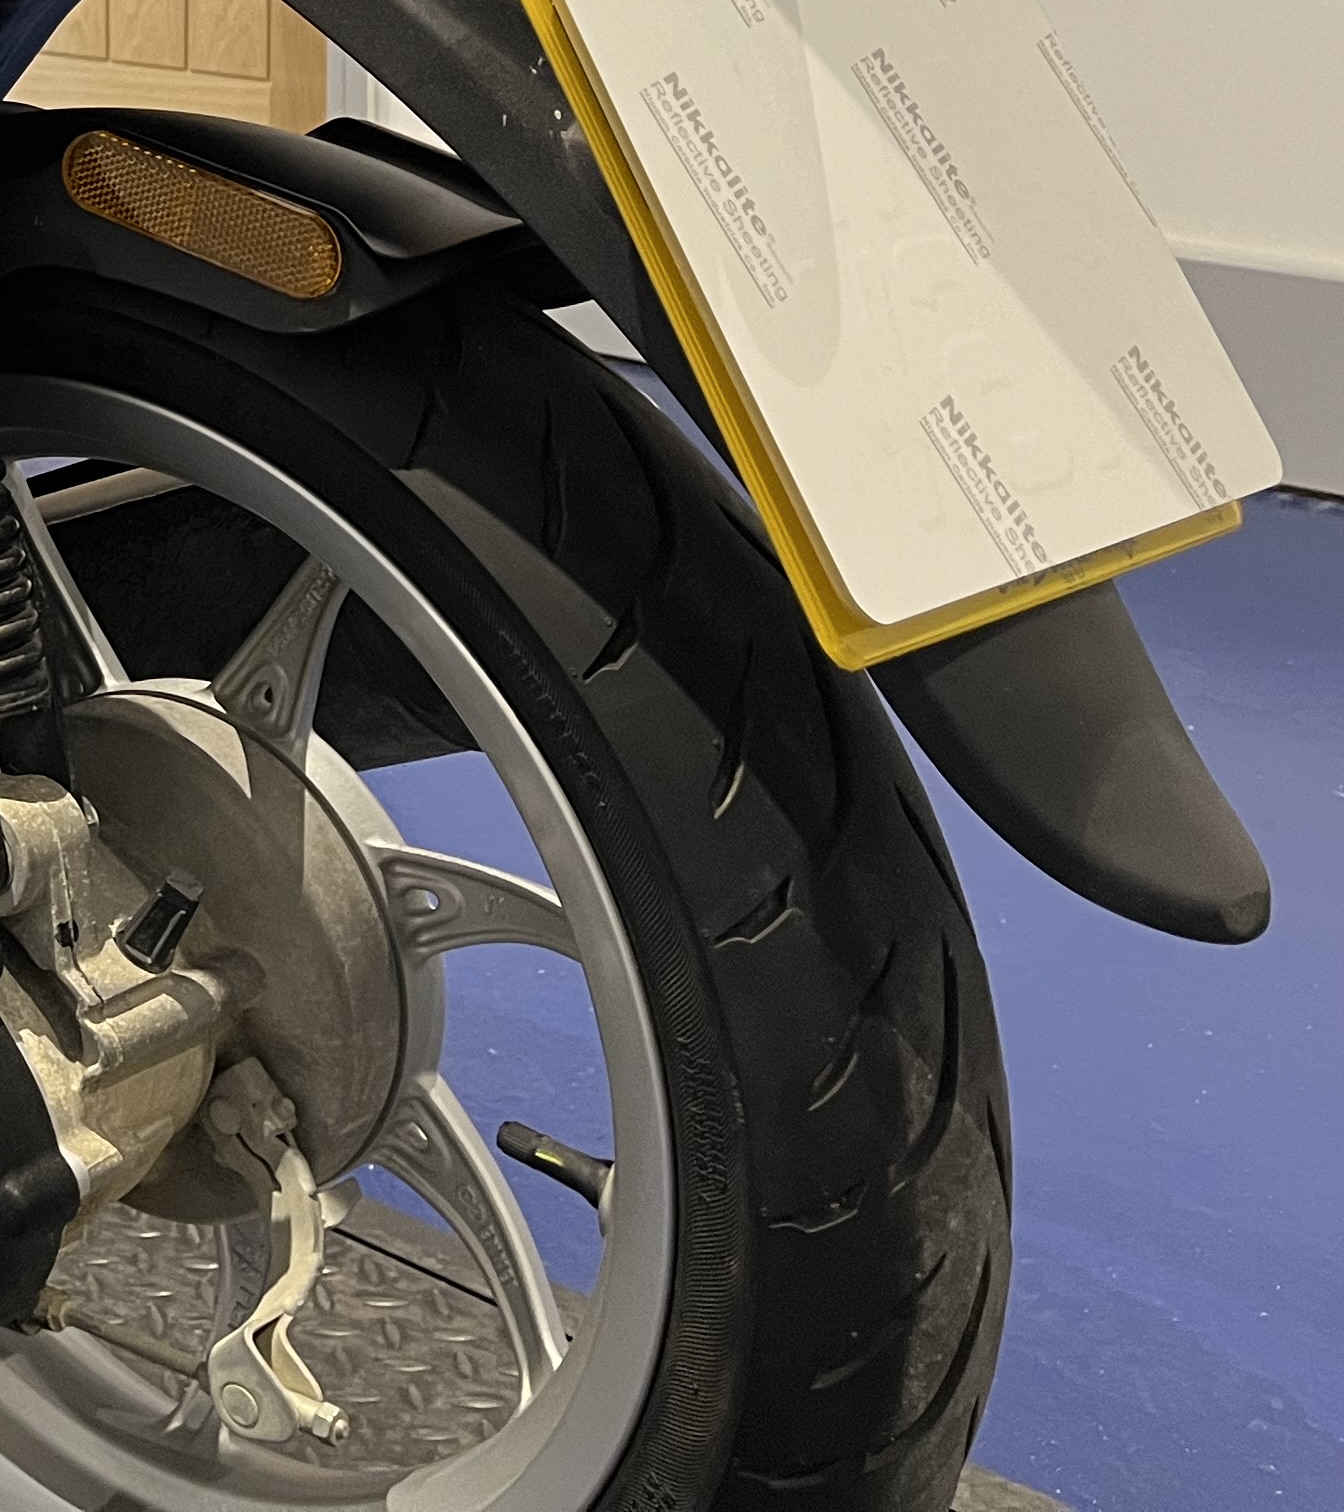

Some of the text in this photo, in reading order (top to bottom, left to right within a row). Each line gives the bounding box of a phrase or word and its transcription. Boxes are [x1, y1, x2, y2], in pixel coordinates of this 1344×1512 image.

[650, 81, 723, 192] Reflective
[720, 197, 790, 302] Sheeting
[663, 71, 768, 234] Nikkalite
[860, 57, 927, 159] Reflective
[927, 163, 992, 260] Sheeting
[871, 47, 969, 199] Nikkalite
[928, 407, 1003, 521] Reflective
[939, 394, 1048, 563] Nikkalite
[1118, 356, 1185, 460] Reflective
[1127, 345, 1227, 498] Nikkalite
